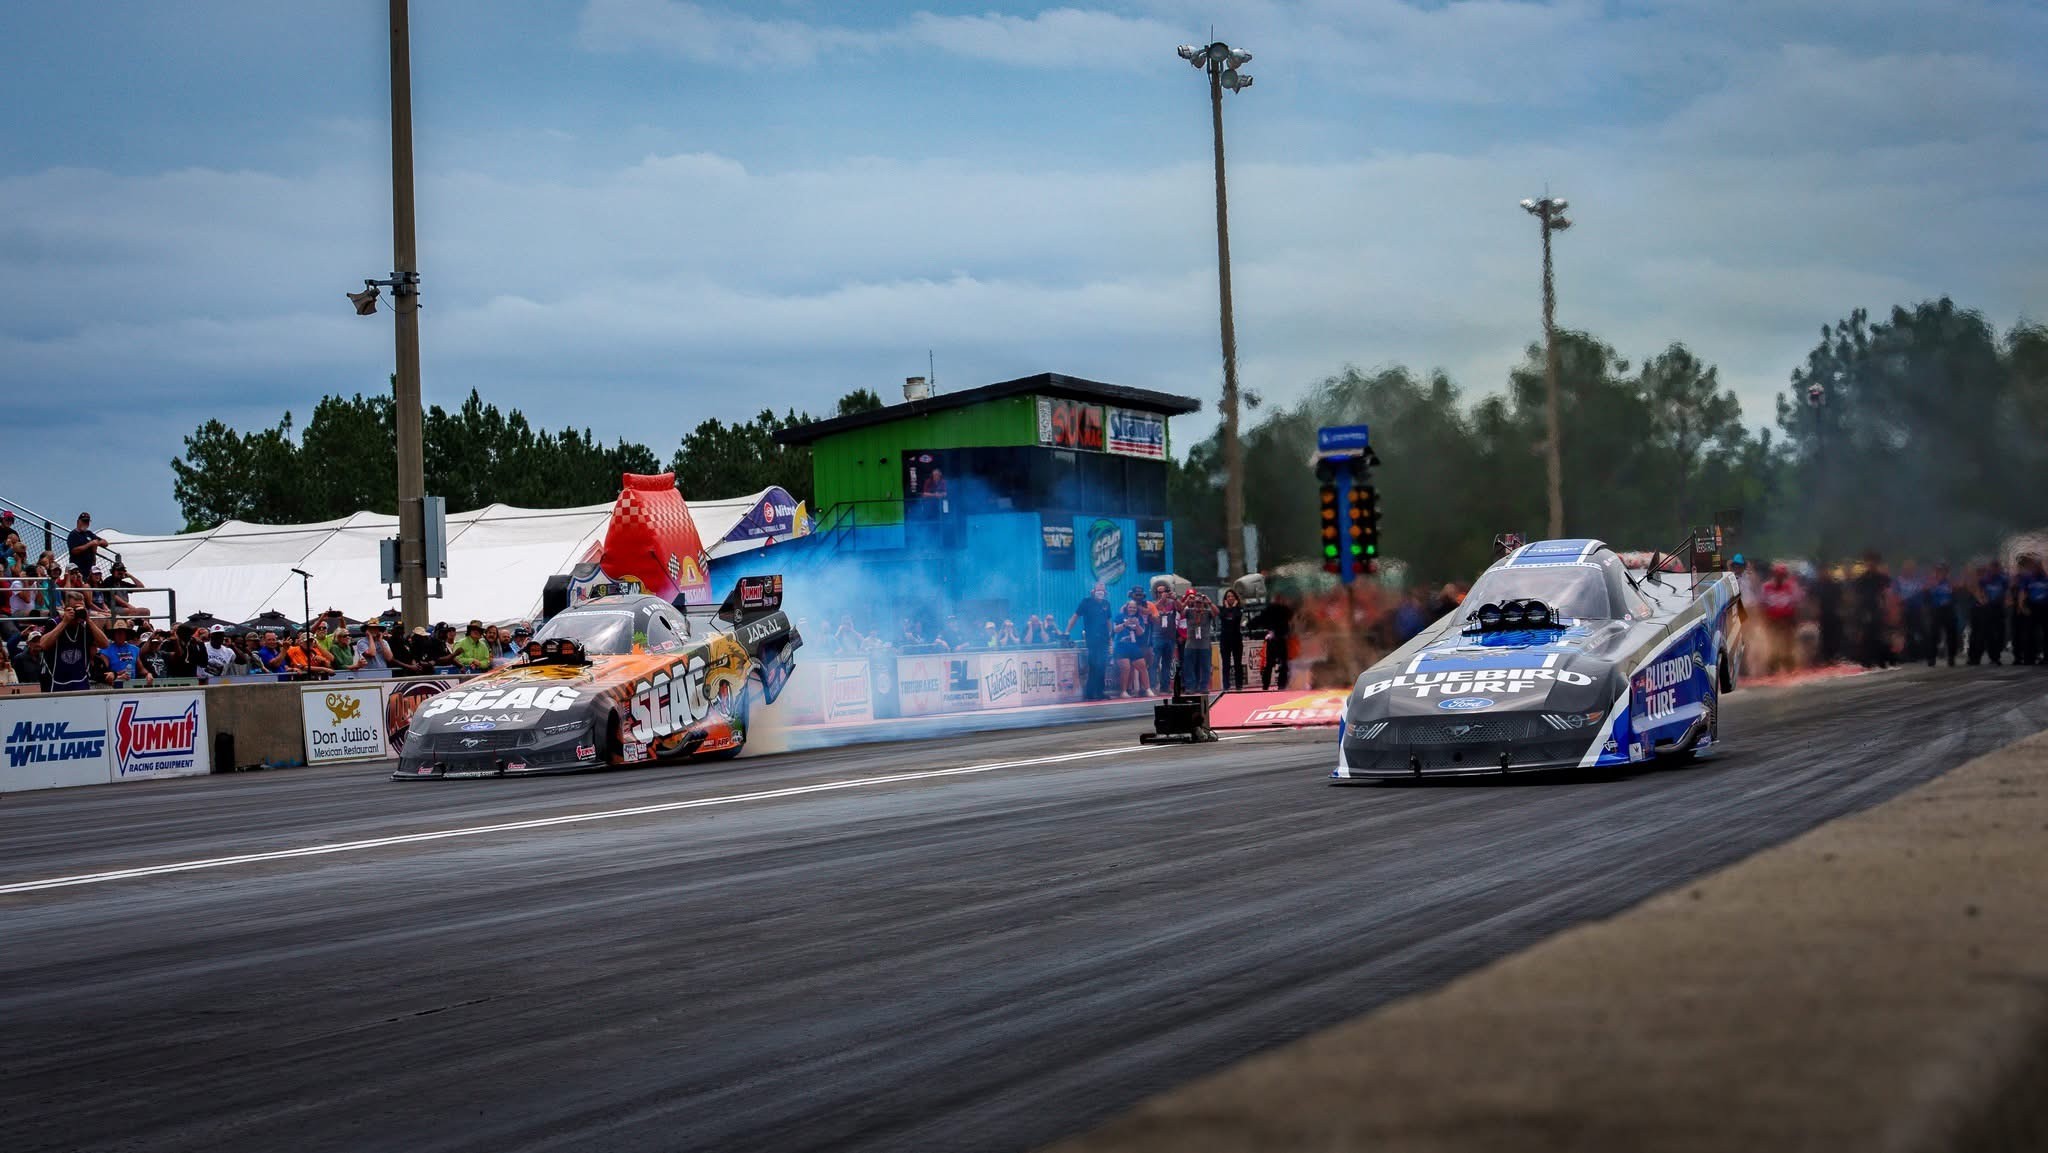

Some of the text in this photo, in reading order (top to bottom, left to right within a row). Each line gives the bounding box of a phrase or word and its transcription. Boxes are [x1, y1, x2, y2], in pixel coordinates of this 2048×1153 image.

[748, 618, 782, 643] JACKAL
[1363, 669, 1593, 699] BLUEBIRD
[1645, 654, 1692, 693] BLUEBIRD
[630, 655, 709, 744] SCAG
[1408, 680, 1537, 698] TURF
[422, 686, 581, 718] SCAG
[1444, 698, 1490, 709] Ford
[1646, 688, 1677, 721] TURF
[443, 711, 524, 726] JACKAL
[463, 722, 492, 731] Ford
[313, 725, 378, 745] Don Julio's
[5, 740, 104, 768] WILLIAMS
[314, 743, 379, 758] Mexican Restaurant
[129, 759, 194, 773] RACING EQUIPMENT
